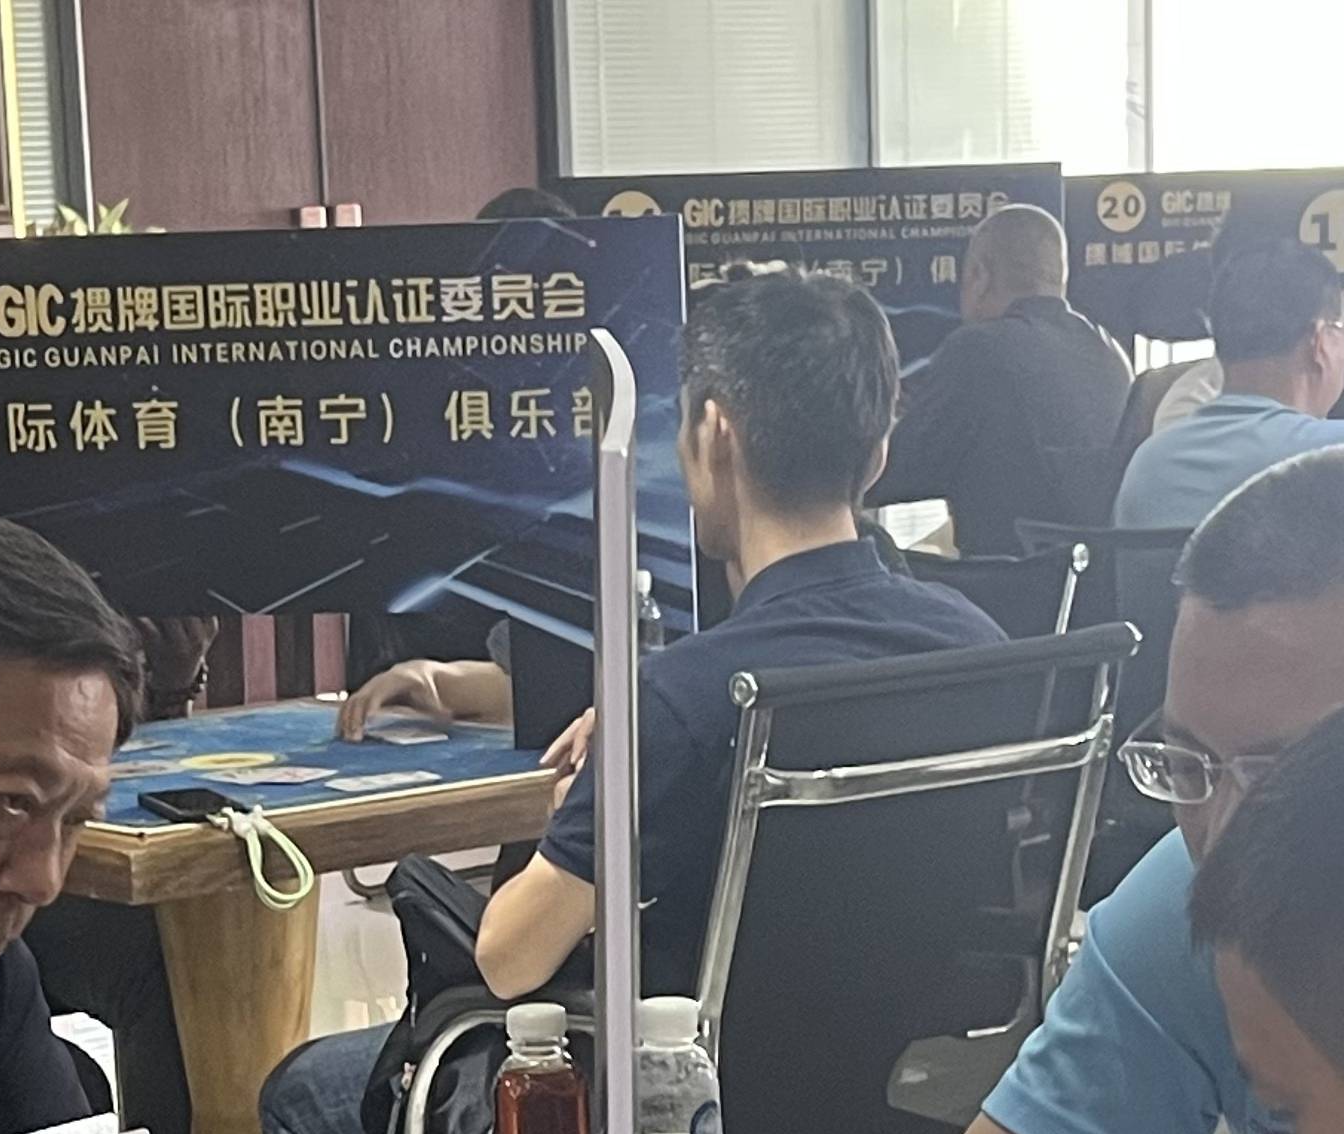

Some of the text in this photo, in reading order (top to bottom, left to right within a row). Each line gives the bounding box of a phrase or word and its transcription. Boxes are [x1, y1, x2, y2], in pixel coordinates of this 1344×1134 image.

[1102, 194, 1140, 218] 20
[45, 344, 159, 368] GUANPAI
[172, 338, 379, 364] INTERNATIONAL
[389, 332, 589, 359] CHAMPIONSHIP
